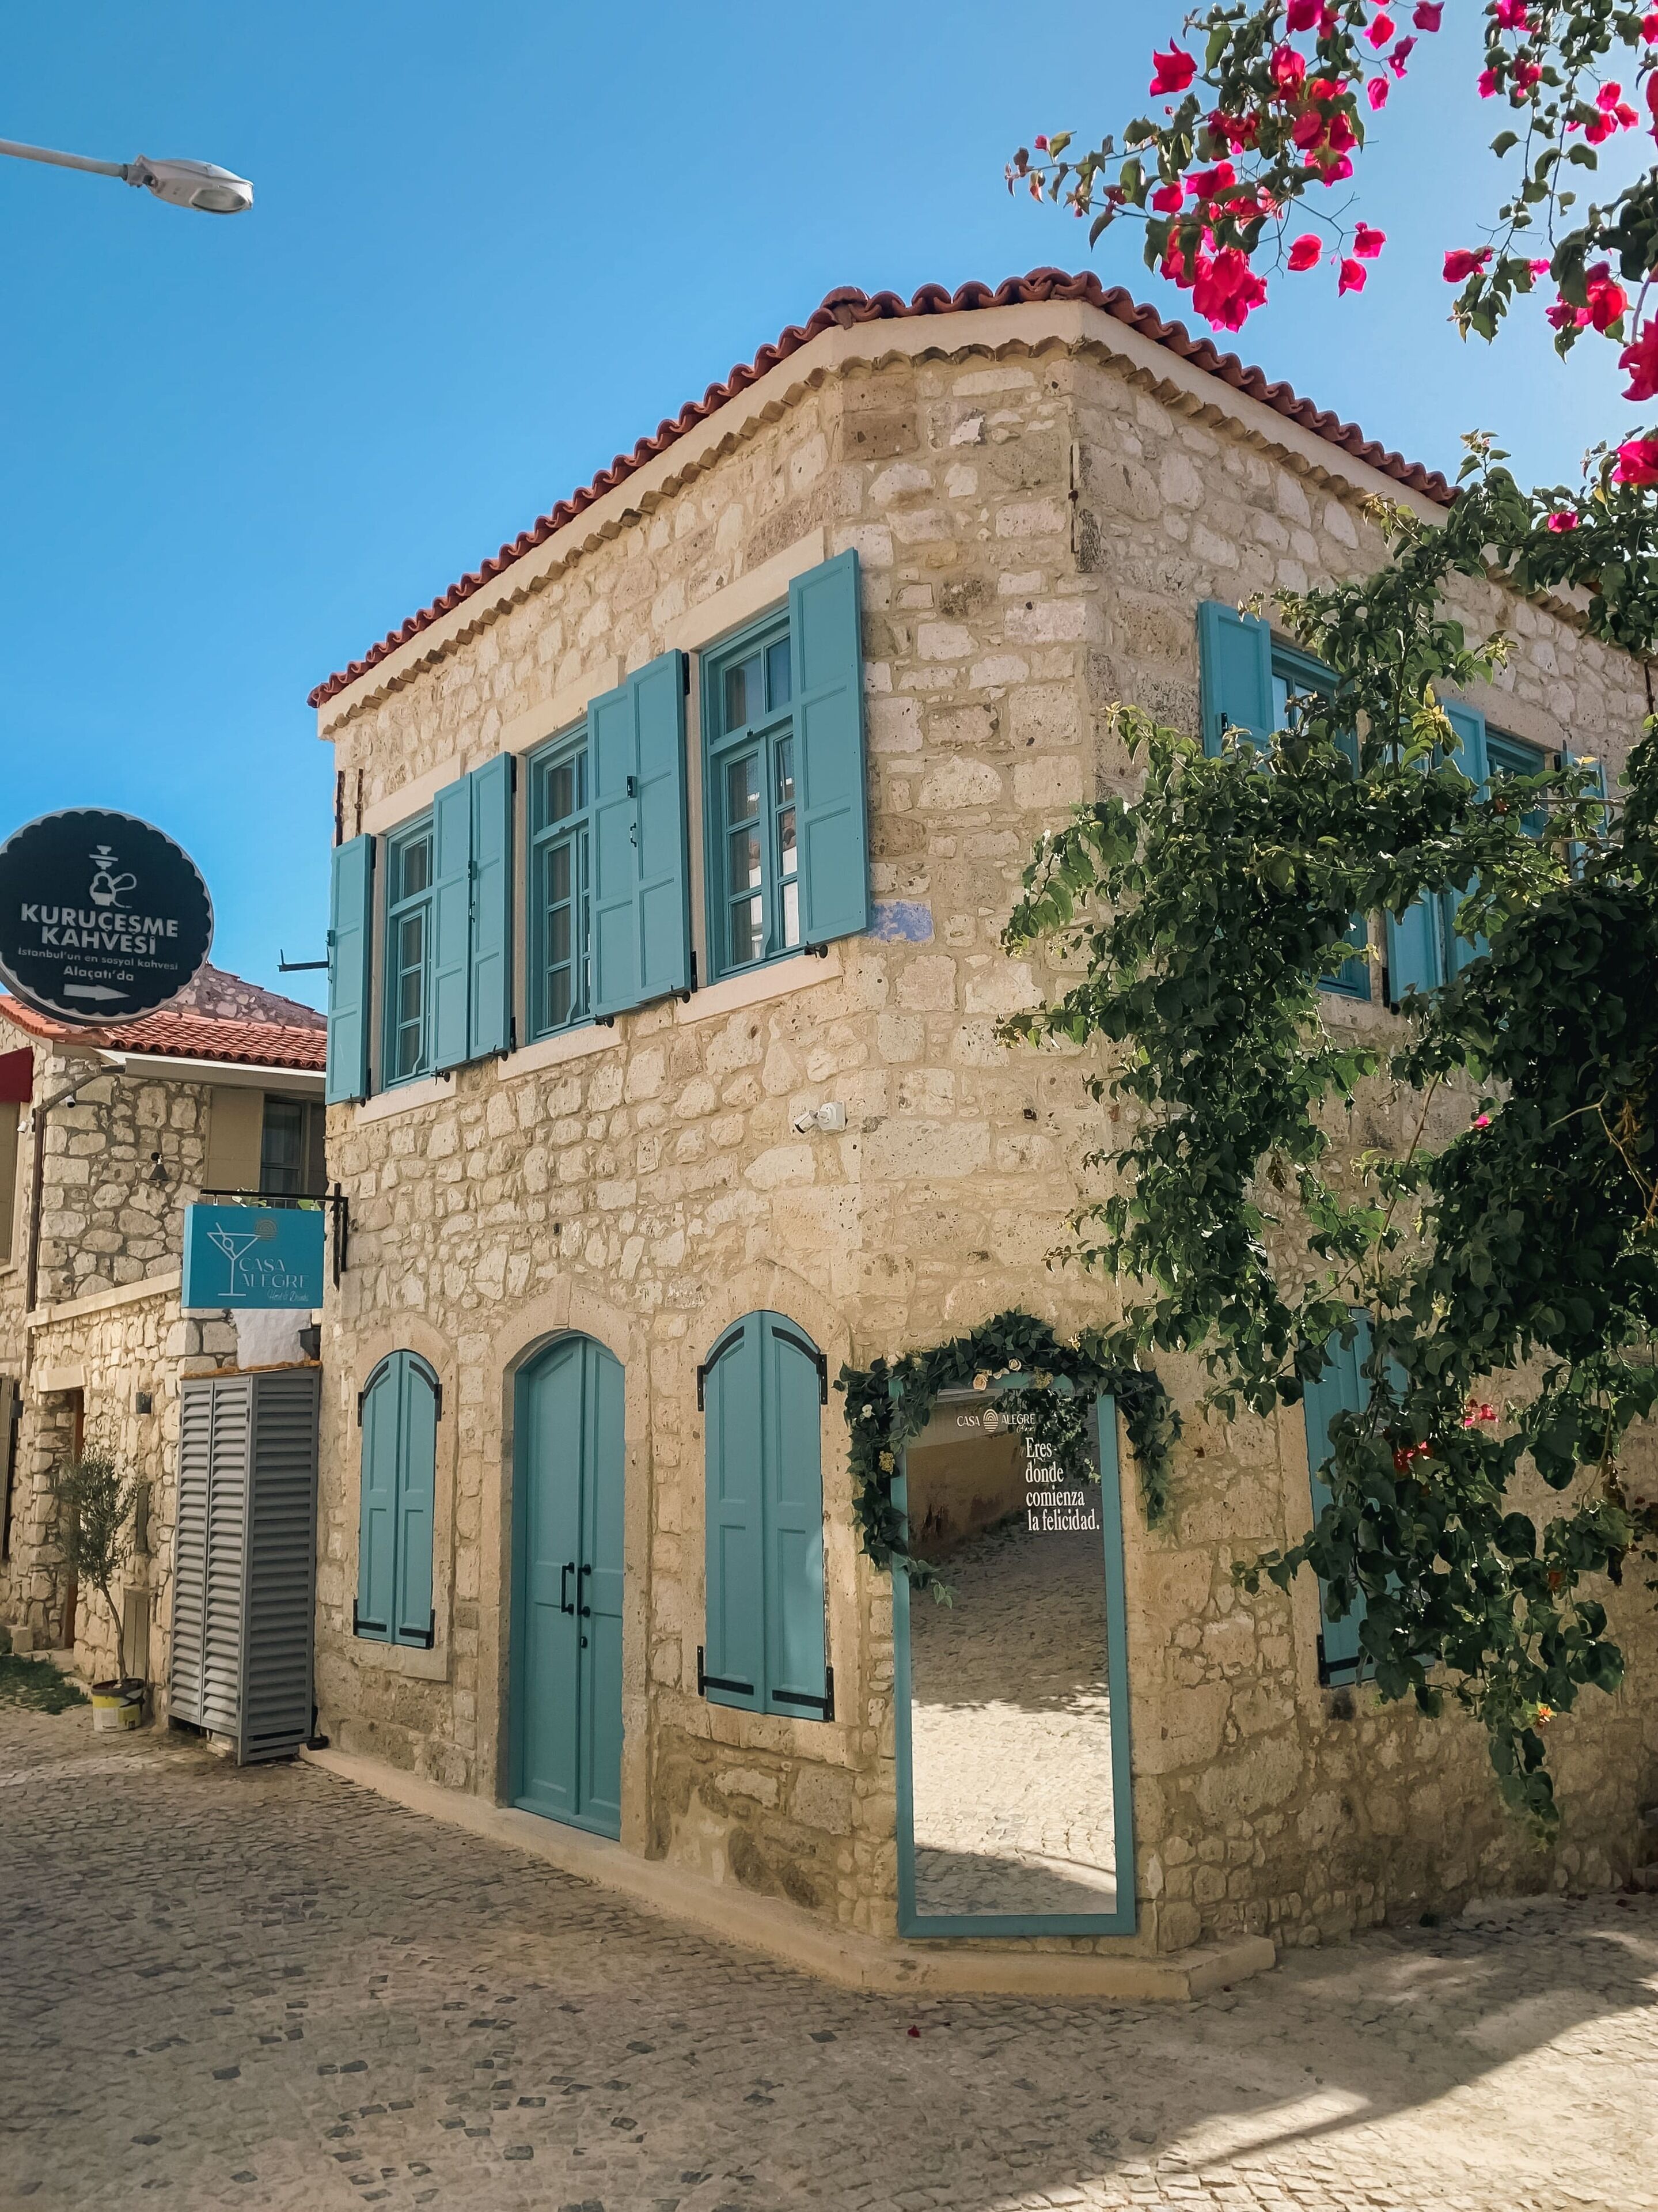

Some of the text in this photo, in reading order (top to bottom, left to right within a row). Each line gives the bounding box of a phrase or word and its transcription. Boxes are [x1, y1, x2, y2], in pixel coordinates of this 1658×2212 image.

[21, 903, 179, 938] KURUÇEŞME
[41, 925, 156, 955] KAHVESİ
[63, 965, 135, 982] Alaçatı'da
[84, 955, 98, 963] en
[101, 956, 134, 967] sosyal
[137, 958, 179, 971] kahvesi
[239, 1257, 286, 1272] CASA
[240, 1273, 309, 1289] ALEGRE
[957, 1414, 1035, 1427] CASA ALEGRE
[1025, 1437, 1053, 1458] Eres
[1025, 1461, 1064, 1483] donde
[1026, 1484, 1086, 1507] comienza
[1027, 1508, 1100, 1531] la felicidad.
